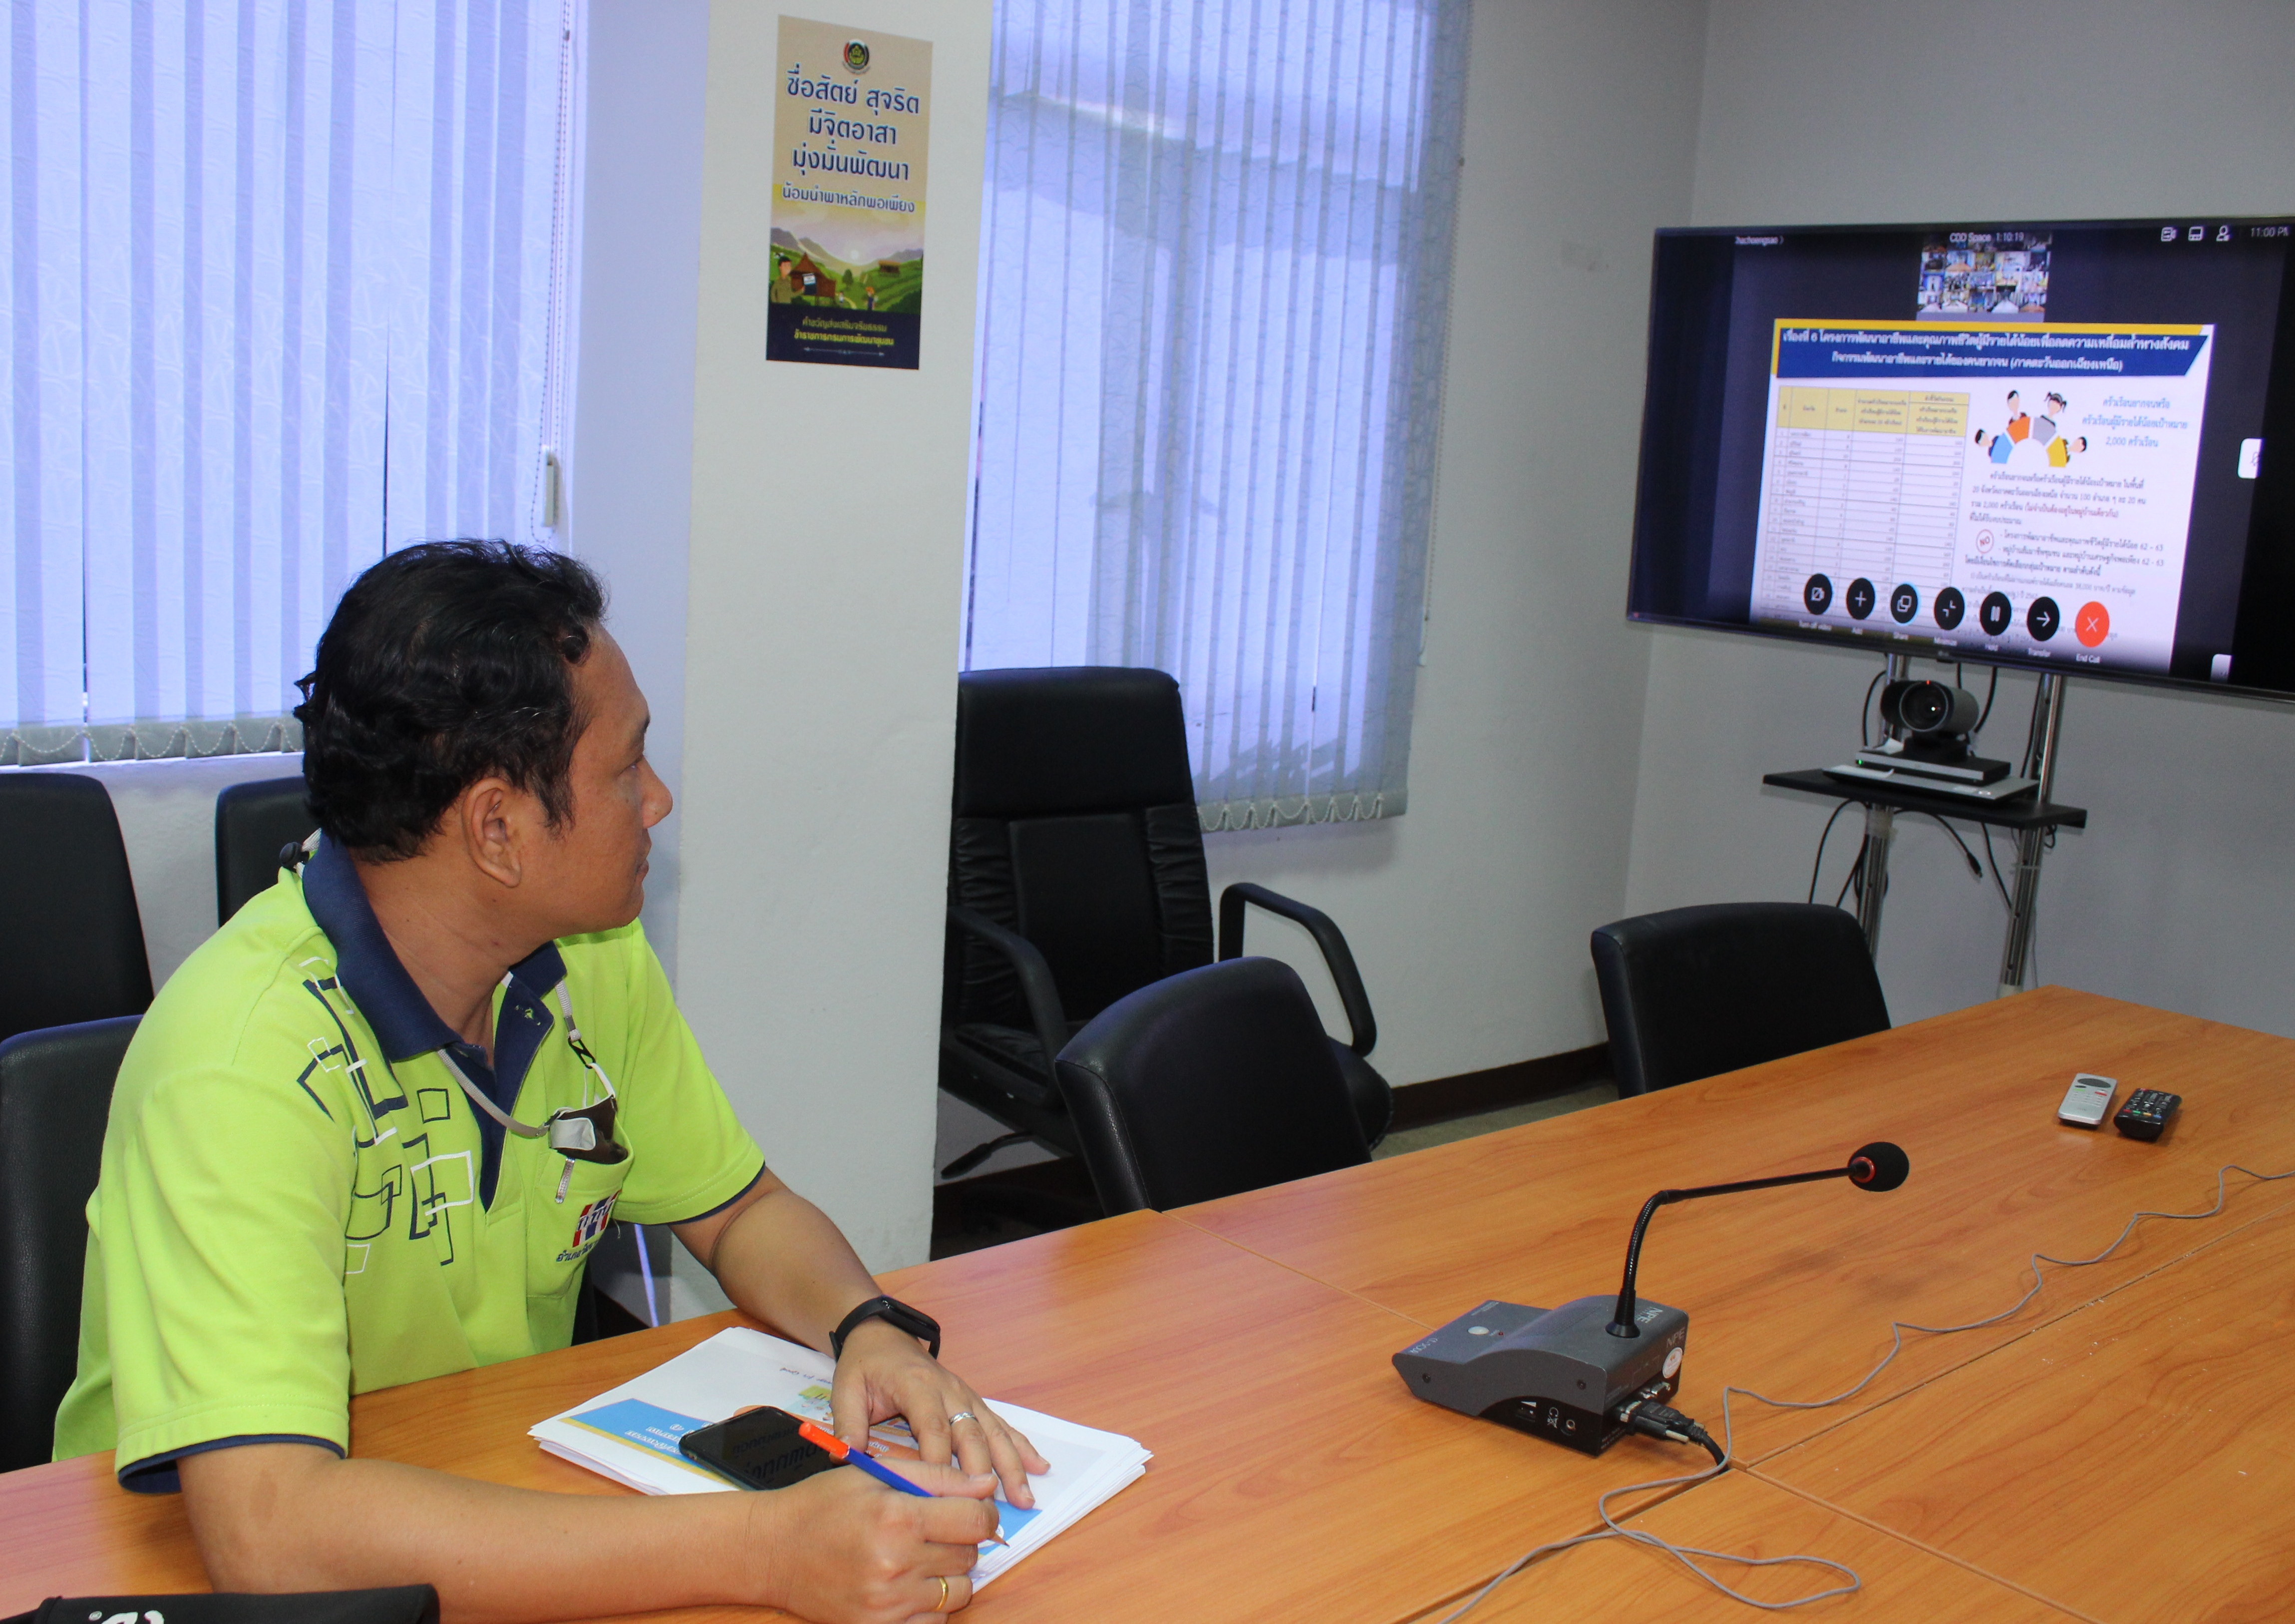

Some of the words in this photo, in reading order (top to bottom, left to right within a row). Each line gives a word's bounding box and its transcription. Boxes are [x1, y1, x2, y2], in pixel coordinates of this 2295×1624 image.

[866, 86, 919, 116] สุจริต
[808, 107, 897, 145] มีจิตอาสา
[792, 138, 909, 180] มุ่งมั่นพัฒนา
[782, 181, 915, 212] น้อมนำพาหลักพอเพียง
[2251, 227, 2276, 237] 11:00
